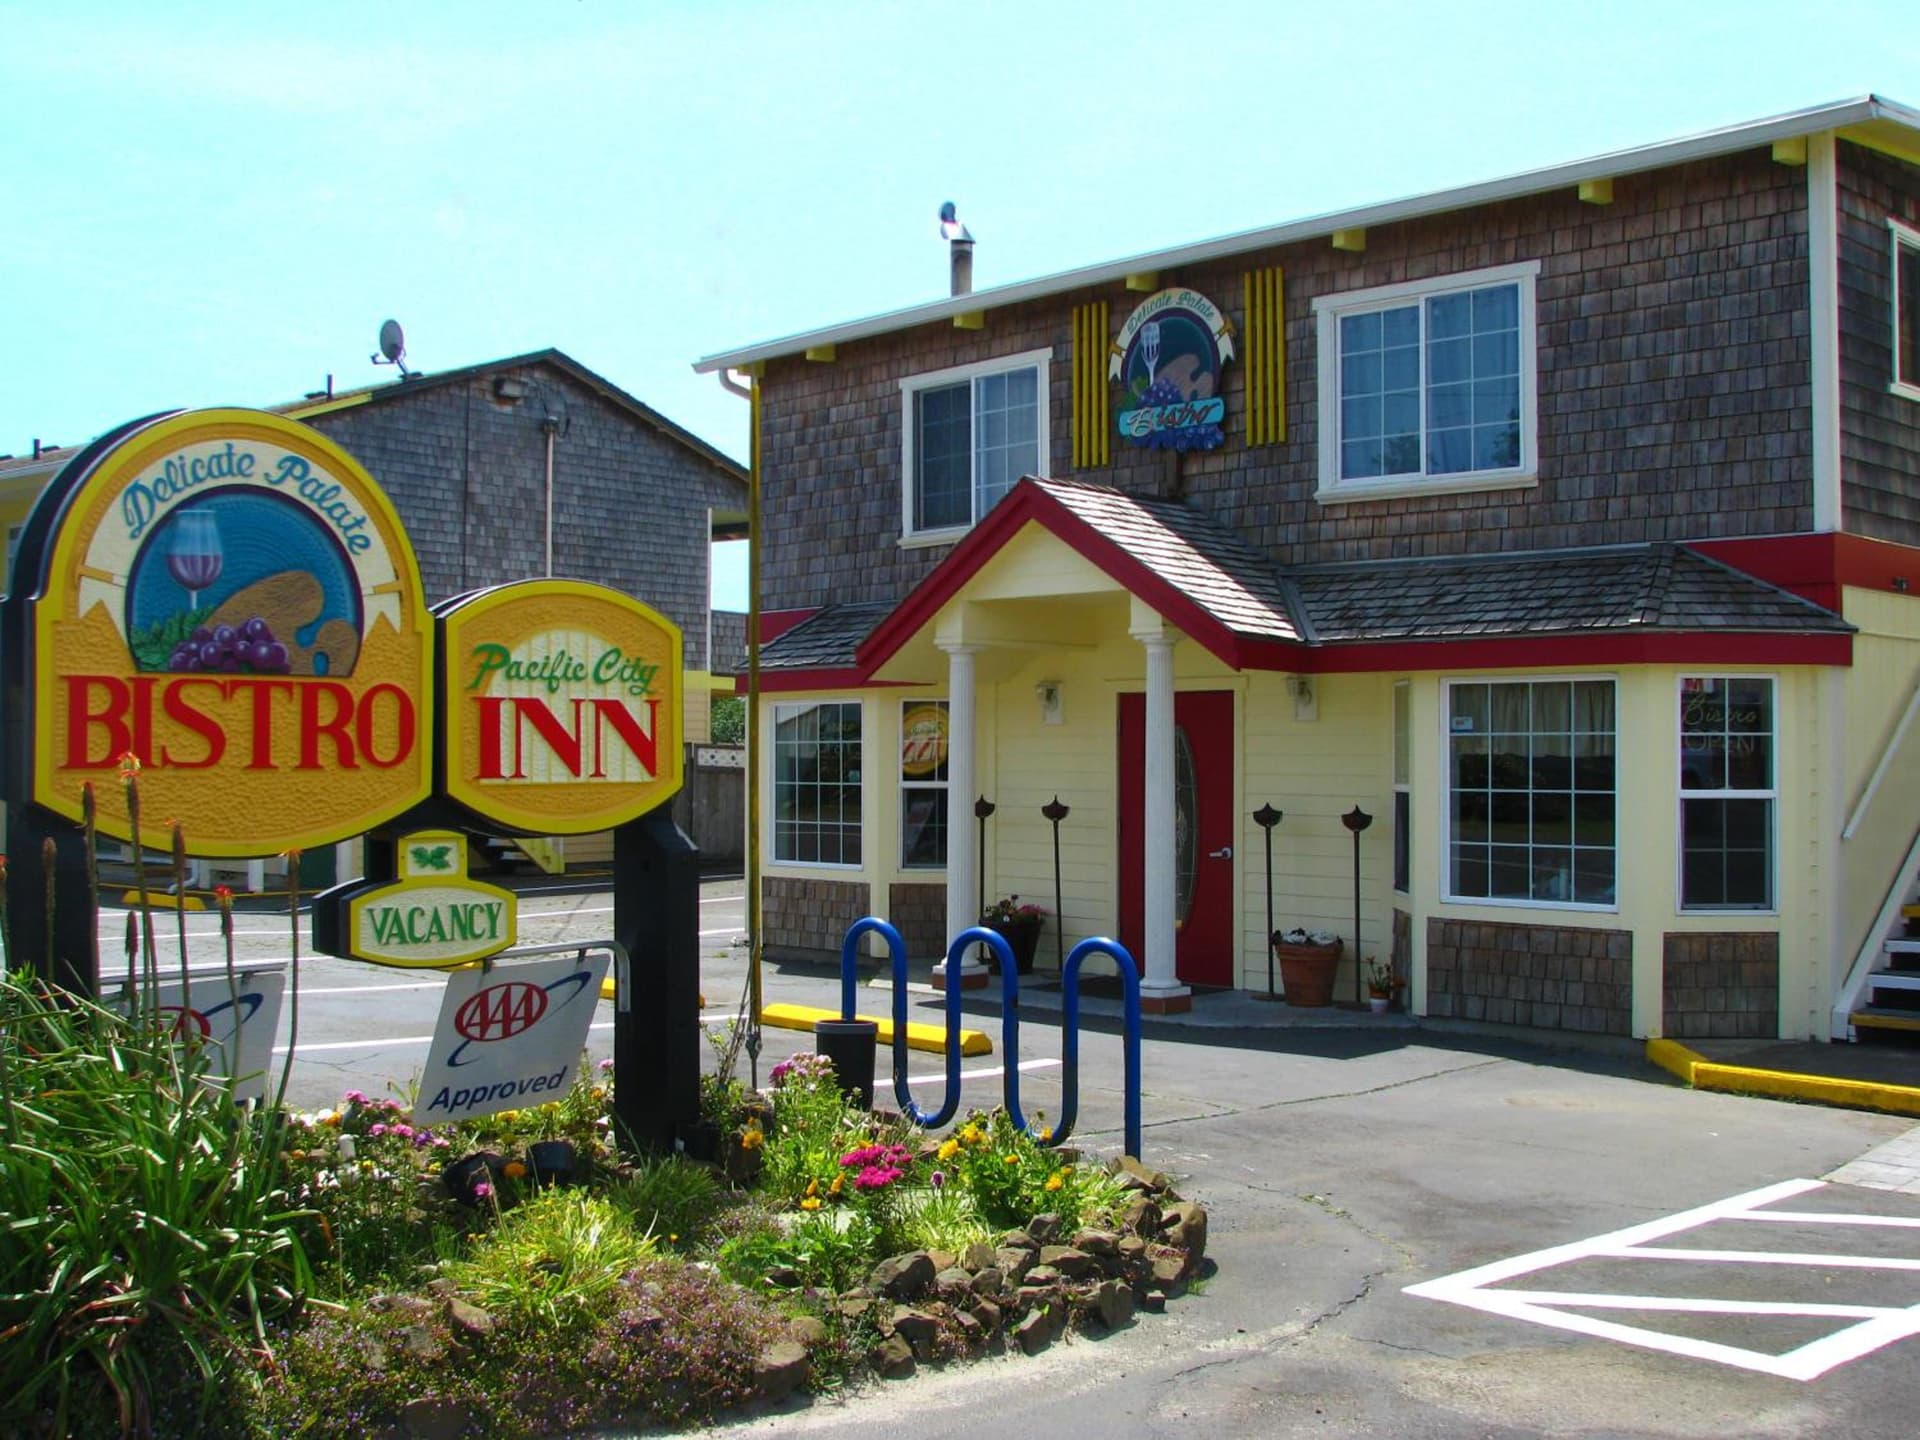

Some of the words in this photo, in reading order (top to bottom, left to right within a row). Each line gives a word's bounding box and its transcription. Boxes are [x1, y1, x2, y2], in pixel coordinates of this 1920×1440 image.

[1127, 292, 1172, 334] Delicate
[1176, 291, 1214, 317] Palate
[1127, 401, 1220, 437] Bistro
[122, 443, 255, 539] Delicate
[264, 454, 371, 556] Palate
[465, 643, 588, 693] Pacific
[592, 648, 660, 696] City
[57, 674, 416, 770] BISTRO
[471, 697, 661, 779] INN
[366, 902, 502, 945] VACANCY
[462, 983, 537, 1041] AAA
[427, 1065, 568, 1113] Approved
